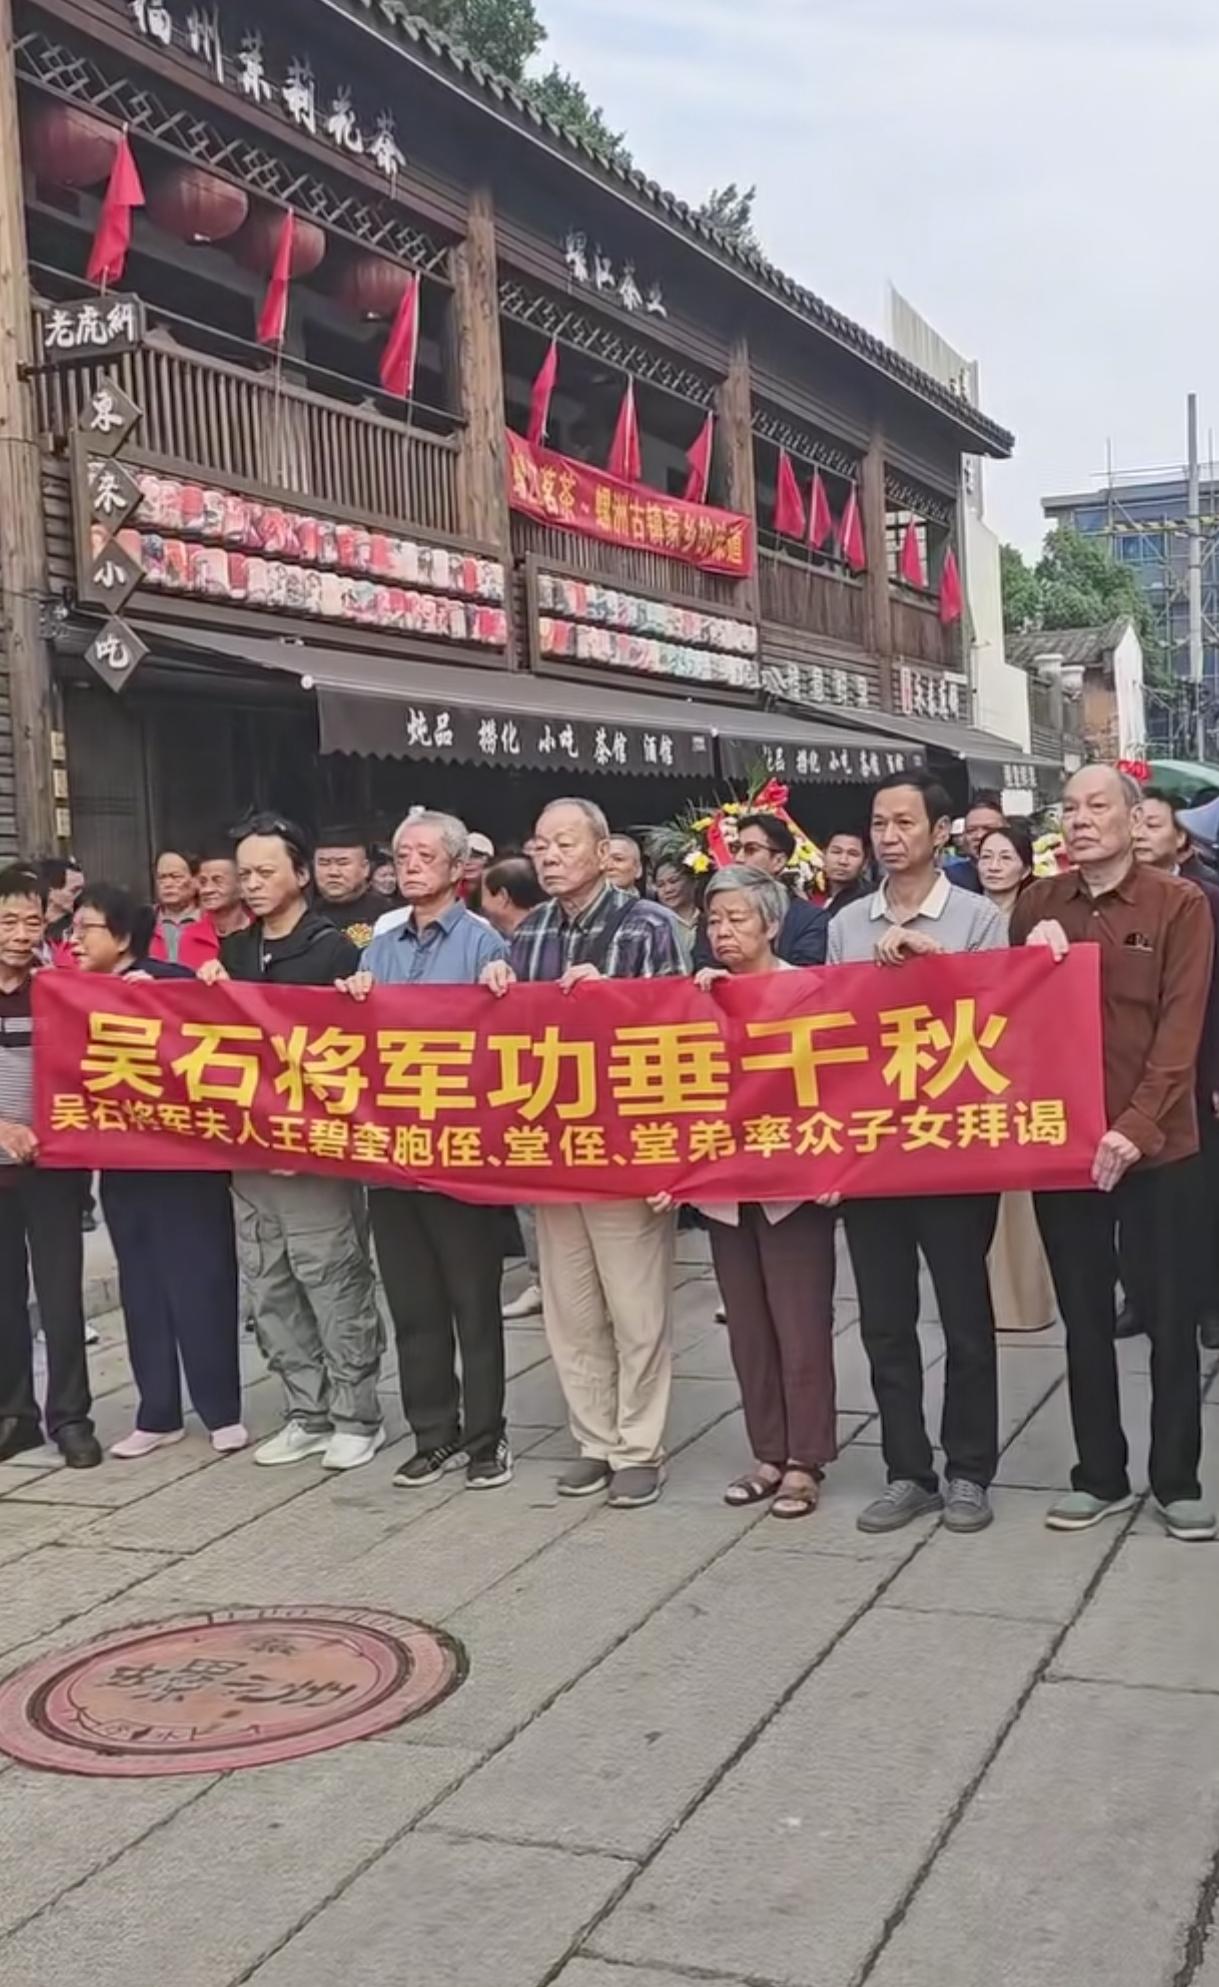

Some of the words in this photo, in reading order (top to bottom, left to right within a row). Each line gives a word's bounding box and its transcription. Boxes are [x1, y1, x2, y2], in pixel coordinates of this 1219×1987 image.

[407, 706, 454, 747] 炖品
[538, 723, 579, 758] 小吃
[80, 998, 1012, 1122] 吴石将军功垂千秋
